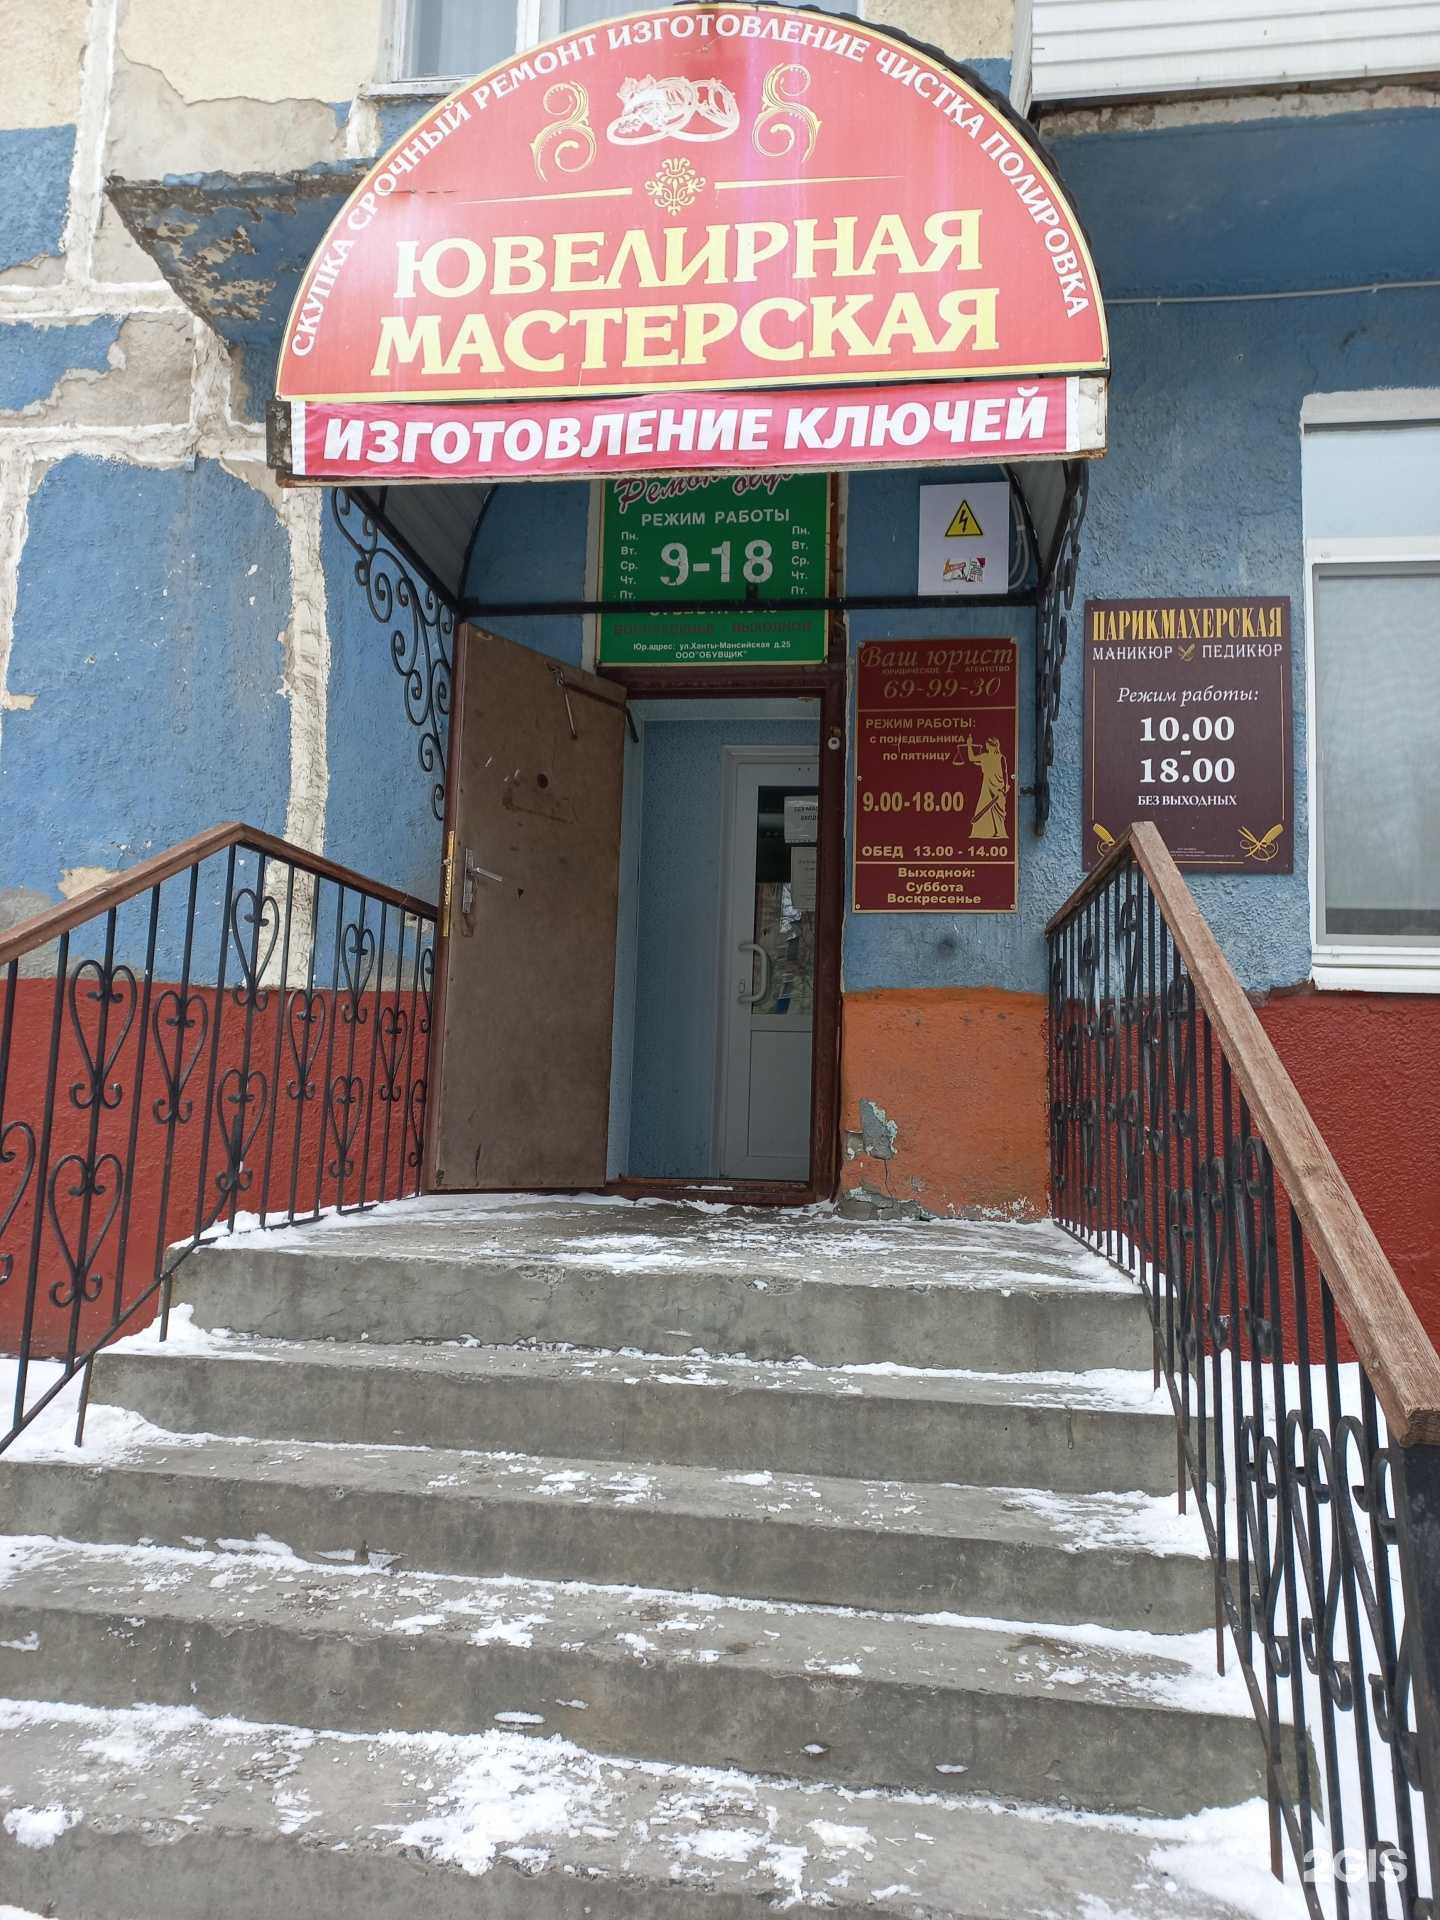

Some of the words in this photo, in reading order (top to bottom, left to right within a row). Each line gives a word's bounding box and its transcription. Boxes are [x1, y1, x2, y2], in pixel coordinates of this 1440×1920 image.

[291, 238, 355, 357] СКУПКА
[347, 101, 472, 232] СРОЧНЫЙ
[471, 33, 597, 110] РЕМОНТ
[606, 14, 871, 63] ИЗГОТОВЛЕНИЕ
[874, 46, 985, 140] ЧИСТКА
[980, 131, 1089, 319] ПОЛИРОВКА
[393, 209, 983, 299] ЮВЕЛИРНАЯ
[370, 288, 1000, 377] МАСТЕРСКАЯ
[323, 408, 768, 465] ИЗГОТОВЛЕНИЕ
[783, 386, 1048, 450] КЛЮЧЕЙ
[641, 512, 706, 527] РЕЖИМ
[715, 508, 790, 524] РАБОТЫ
[621, 532, 639, 541] Пн.
[792, 526, 810, 535] Пн.
[620, 546, 637, 556] Вт.
[791, 541, 809, 550] Вт.
[620, 561, 638, 572] Ср.
[660, 539, 773, 586] 9-18
[791, 556, 810, 566] Ср.
[791, 571, 808, 580] Чт.
[791, 586, 808, 595] Пт.
[1092, 607, 1283, 641] ПАРИКМАХЕРСКАЯ
[1093, 646, 1173, 660] МАНИКЮР
[1202, 643, 1283, 658] ПЕДИКЮР
[862, 647, 919, 669] Ваш
[927, 647, 1014, 673] юрист
[884, 677, 1001, 699] 69-99-30
[1117, 687, 1177, 702] Режим
[1180, 685, 1259, 707] работы:
[865, 719, 913, 729] РЕЖИМ
[917, 718, 976, 728] РАБОТЫ:
[1140, 716, 1235, 742] 10.00
[1140, 757, 1236, 783] 18.00
[862, 791, 964, 812] 9.00-18.00
[1138, 795, 1160, 806] БЕЗ
[1162, 794, 1238, 806] ВЫХОДНЫХ
[862, 846, 904, 858] ОБЕД
[913, 846, 954, 857] 13.00
[967, 846, 1008, 857] 14.00
[898, 867, 976, 879] Выходной:
[906, 881, 964, 894] Суббота
[887, 893, 982, 905] Воскресенье
